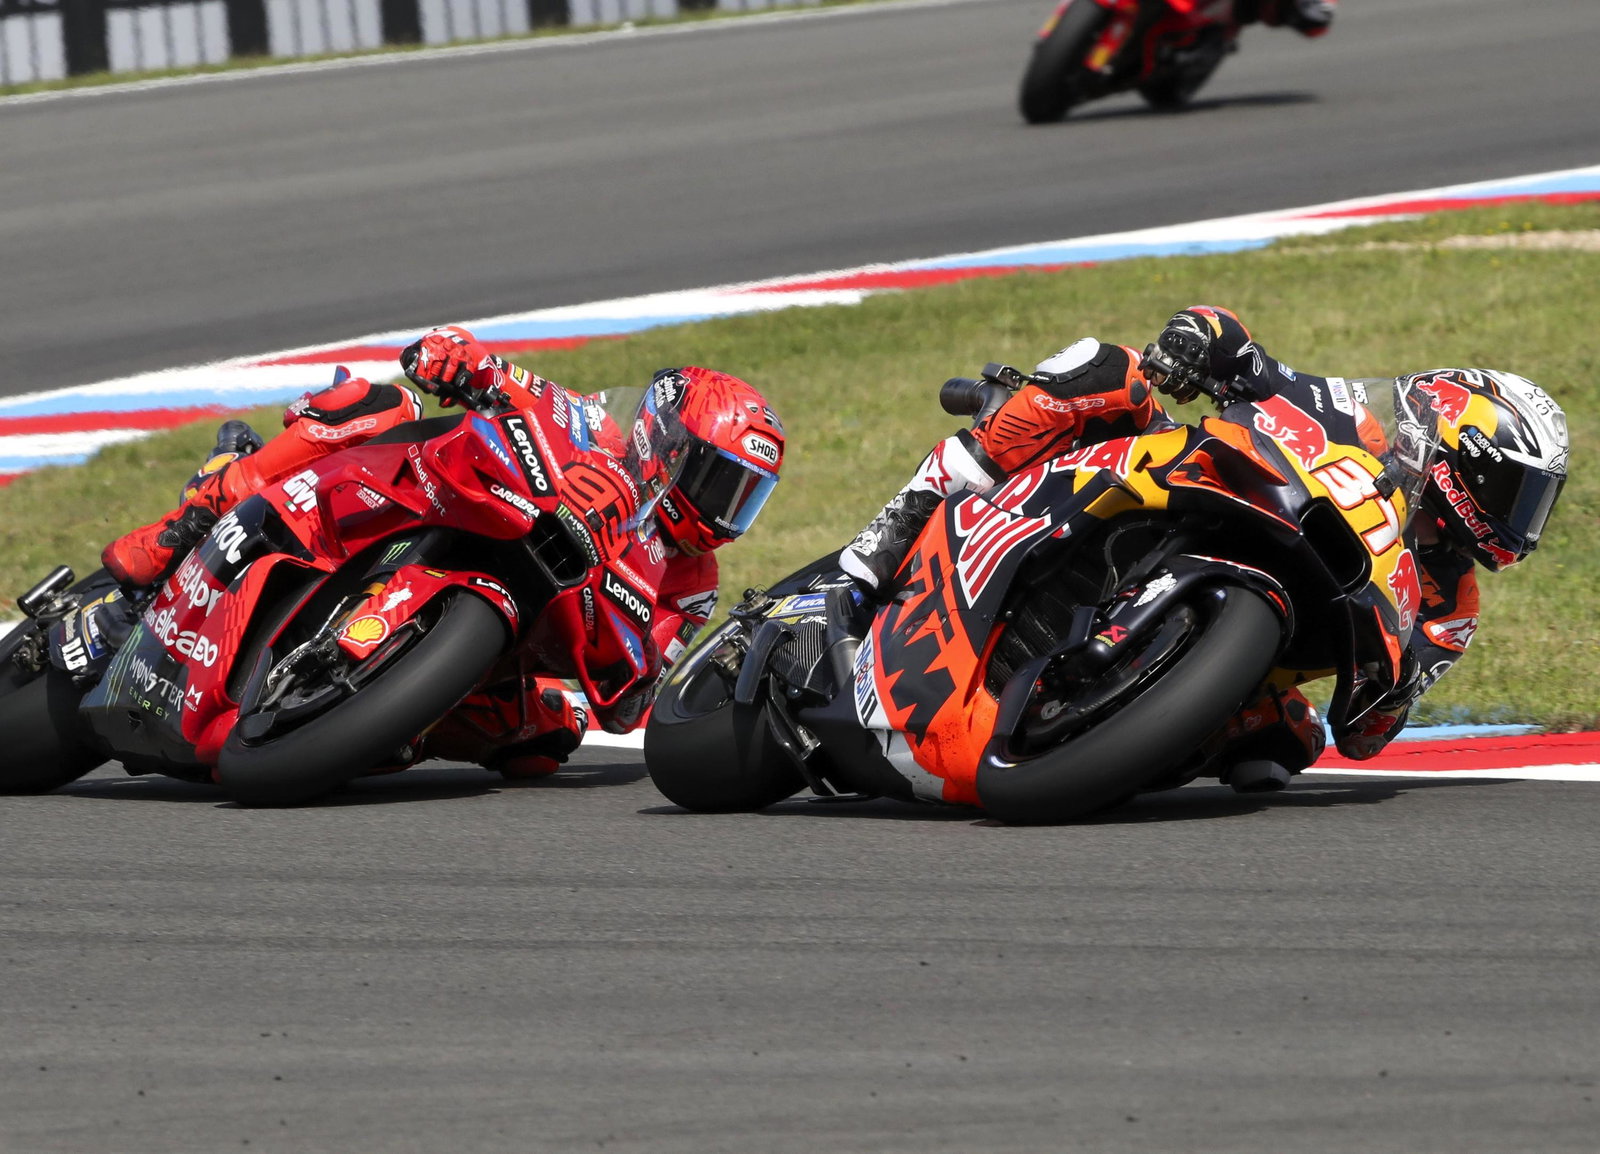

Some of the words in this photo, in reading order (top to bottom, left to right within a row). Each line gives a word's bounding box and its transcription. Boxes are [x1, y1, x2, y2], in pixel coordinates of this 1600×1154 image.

[489, 439, 510, 466] TIM
[506, 418, 548, 491] Lenovo
[750, 438, 777, 462] SHOEI
[414, 457, 428, 484] Audi
[424, 483, 447, 517] Sport
[490, 484, 540, 518] CARRERA
[1431, 460, 1467, 507] Red
[1455, 500, 1494, 539] Bull
[583, 587, 595, 631] CARRERA
[605, 572, 650, 623] Lenovo
[129, 655, 184, 712] MONSTER
[129, 686, 170, 721] ENERGY
